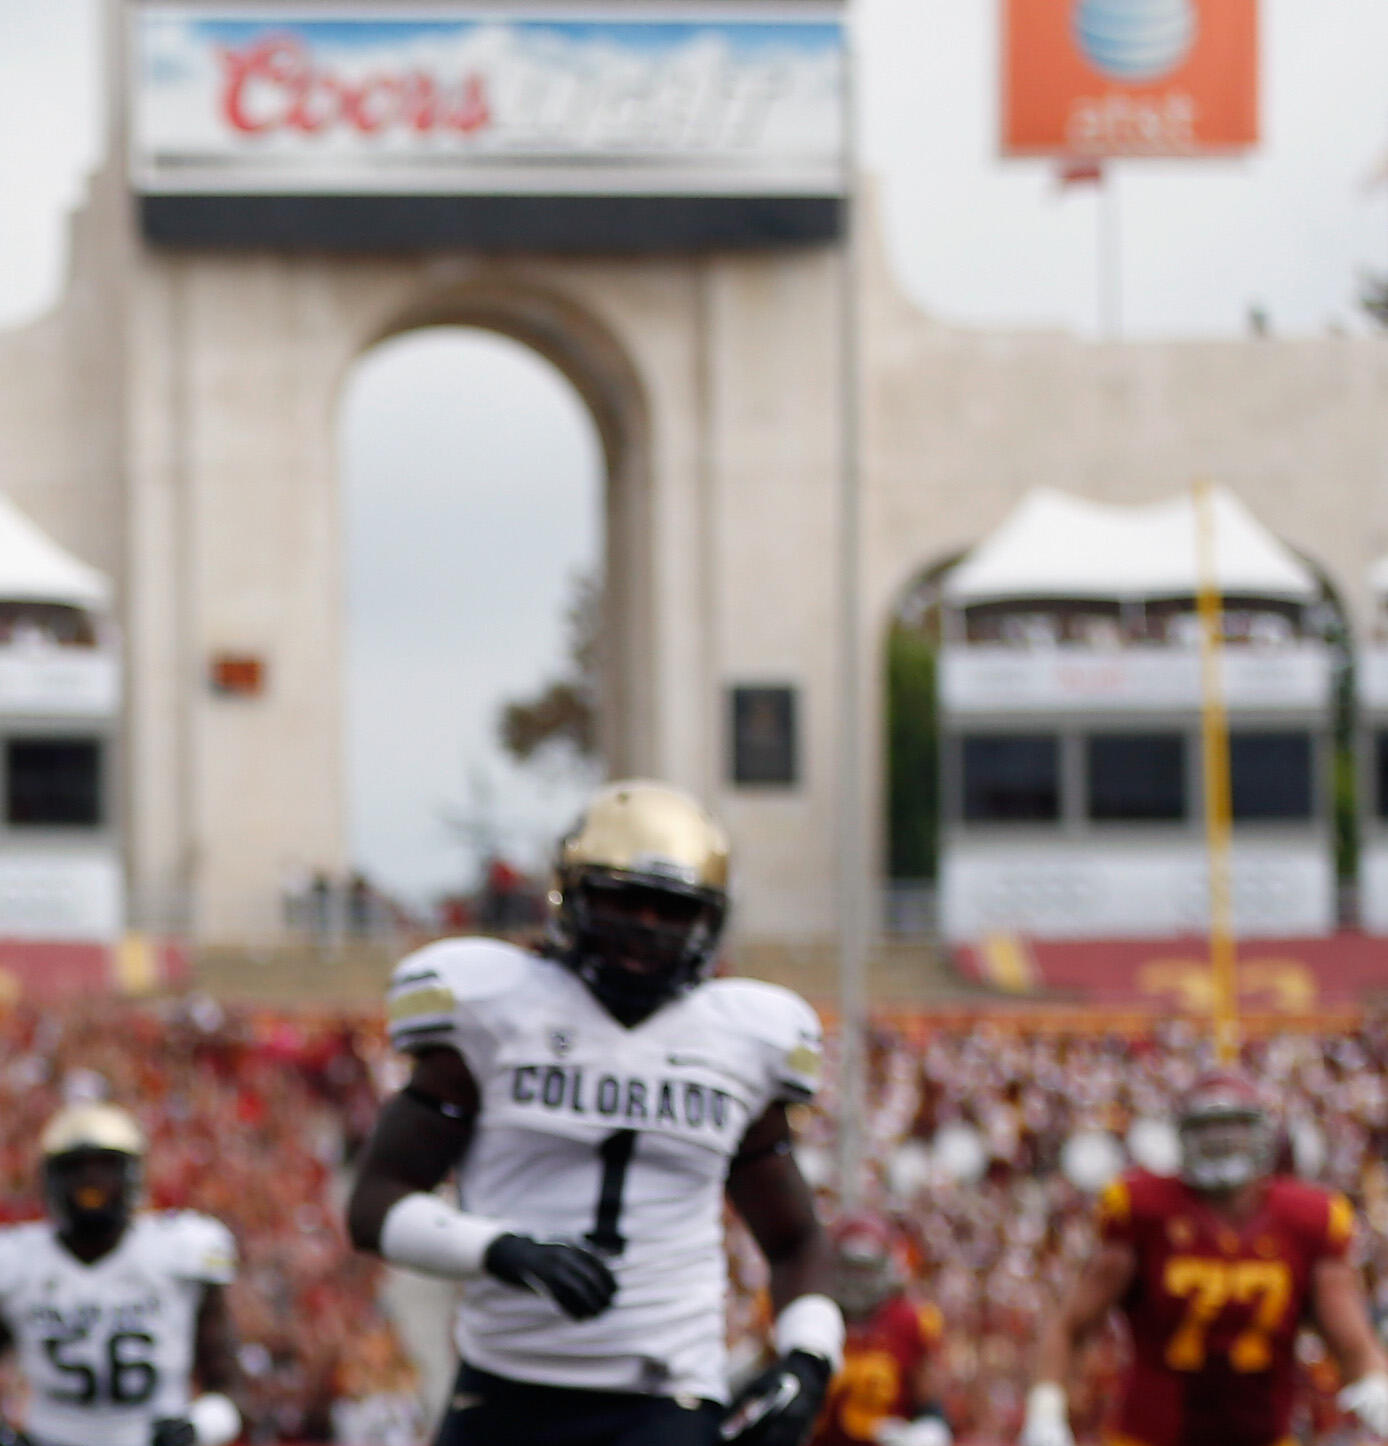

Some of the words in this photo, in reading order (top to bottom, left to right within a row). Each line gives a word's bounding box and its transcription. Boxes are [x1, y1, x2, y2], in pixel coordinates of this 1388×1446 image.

[214, 30, 492, 137] Coors
[584, 1128, 637, 1256] 1
[43, 1329, 160, 1405] 56
[1164, 1258, 1291, 1372] 77
